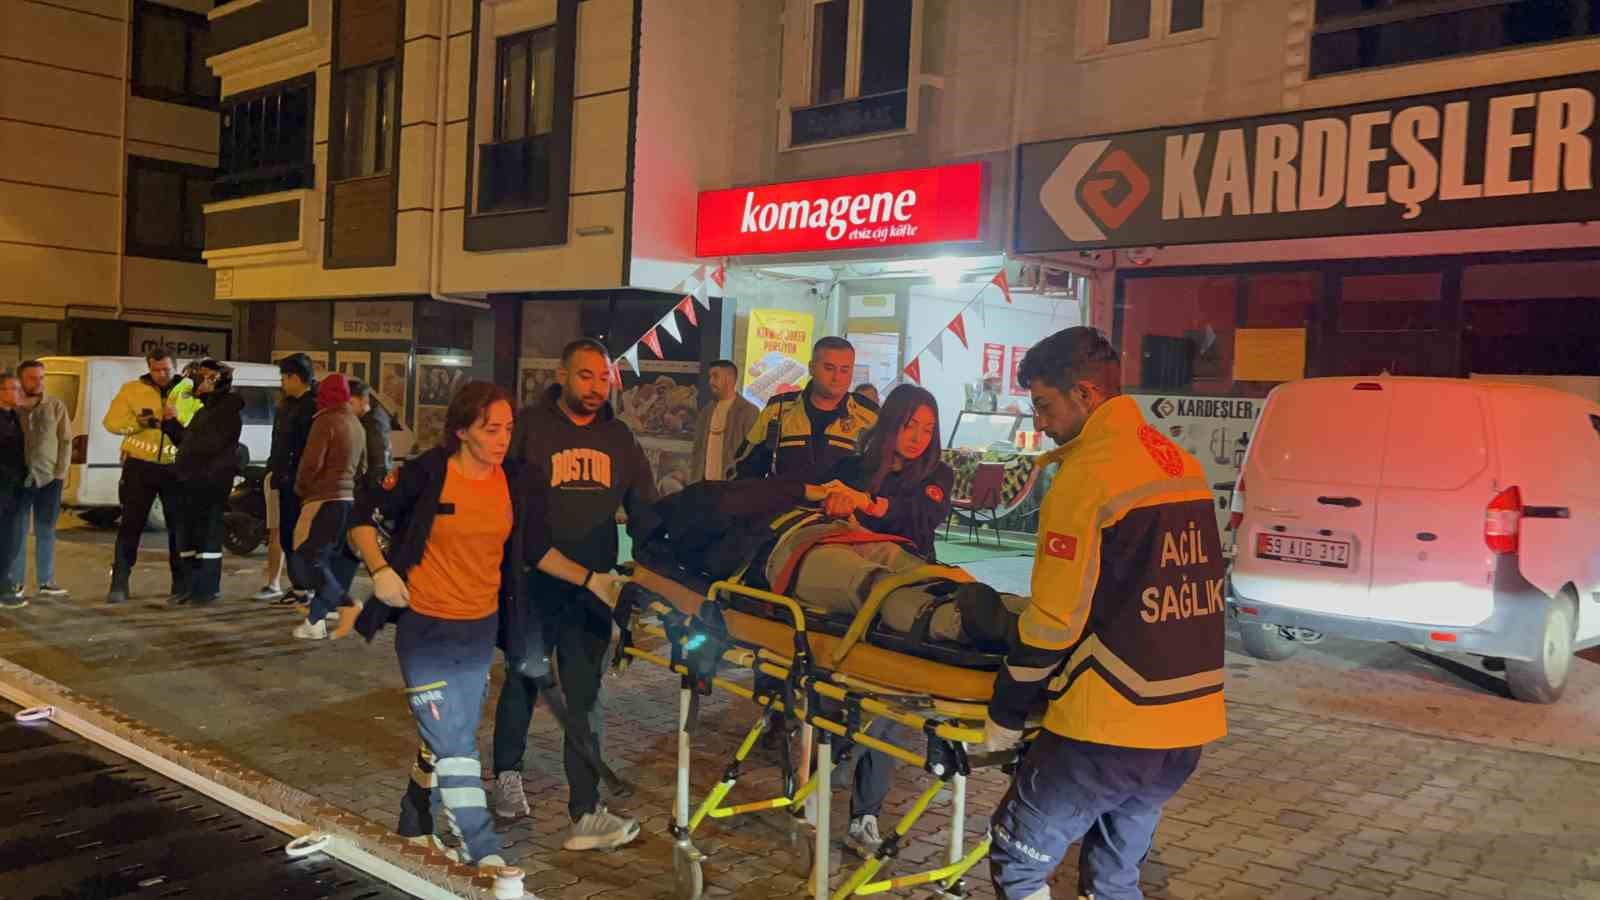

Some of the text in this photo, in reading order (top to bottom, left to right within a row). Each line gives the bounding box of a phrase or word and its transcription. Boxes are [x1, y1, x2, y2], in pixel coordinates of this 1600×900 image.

[1161, 87, 1594, 219] KARDEŞLER
[741, 190, 917, 240] komagene
[890, 224, 918, 238] köfte
[1161, 522, 1208, 568] ACİL
[1141, 576, 1224, 623] SAĞLIK
